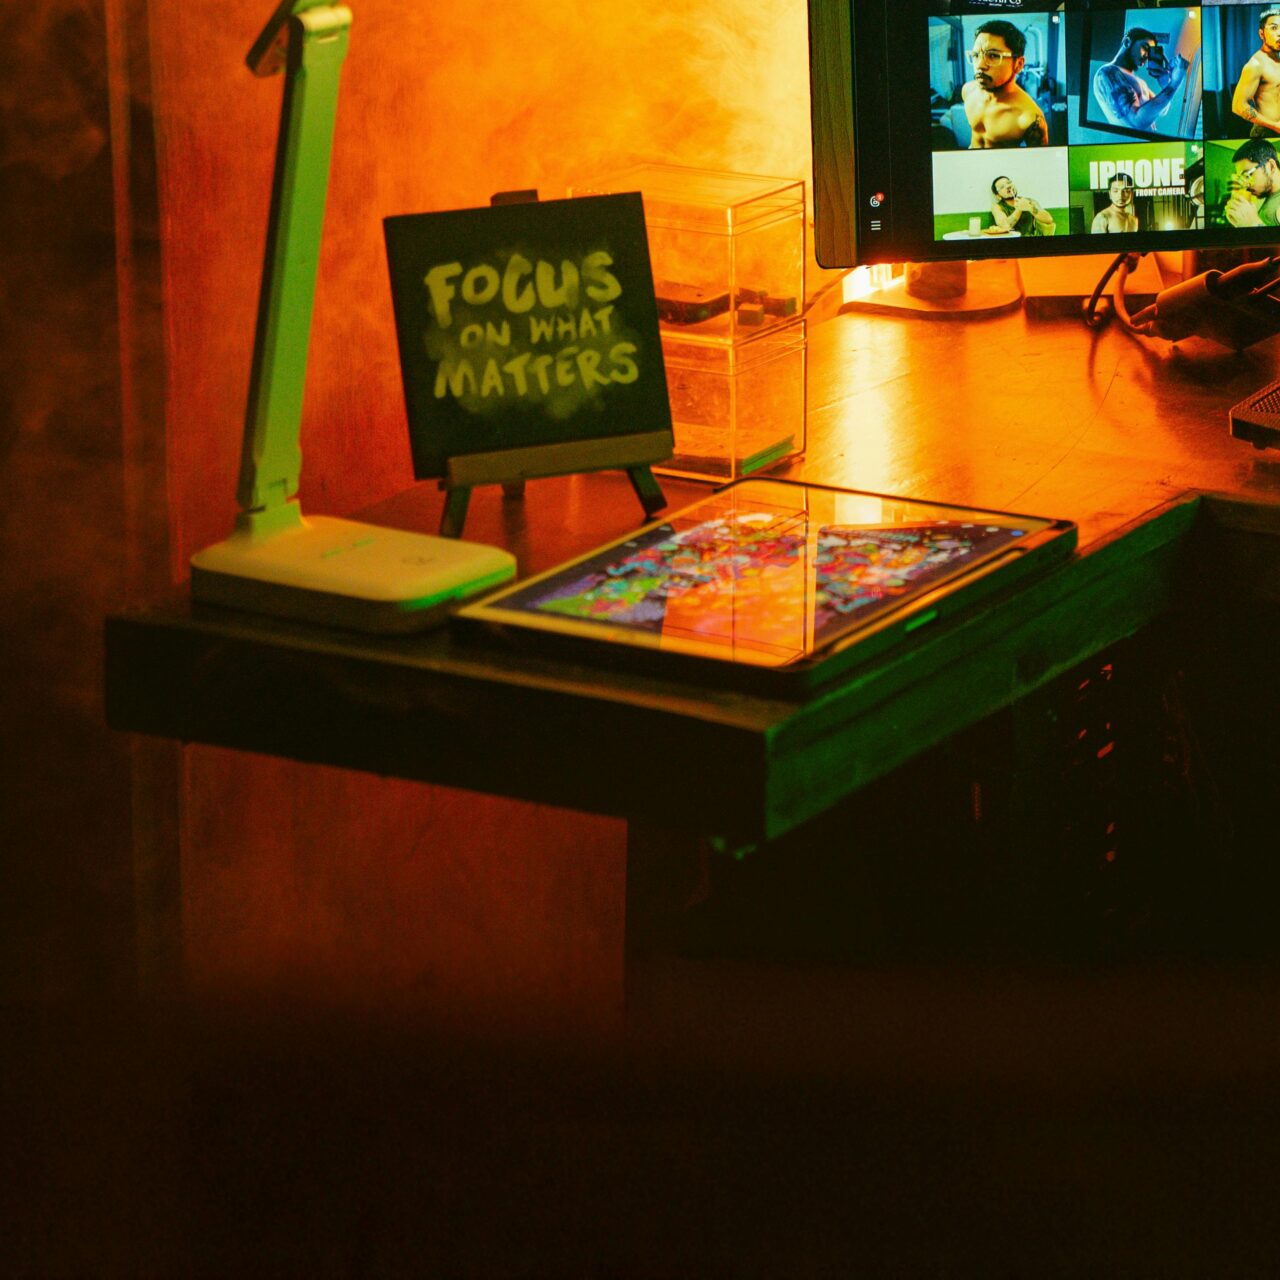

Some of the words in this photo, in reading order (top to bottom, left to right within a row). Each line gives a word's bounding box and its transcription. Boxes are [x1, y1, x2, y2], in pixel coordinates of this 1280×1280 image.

[1089, 158, 1185, 190] IPHONE
[1135, 188, 1157, 197] FRONT
[1157, 187, 1185, 196] CAMERA
[424, 251, 622, 328] FOCUS
[460, 321, 511, 348] ON
[529, 305, 614, 345] WHAT
[433, 342, 639, 399] MATTERS
